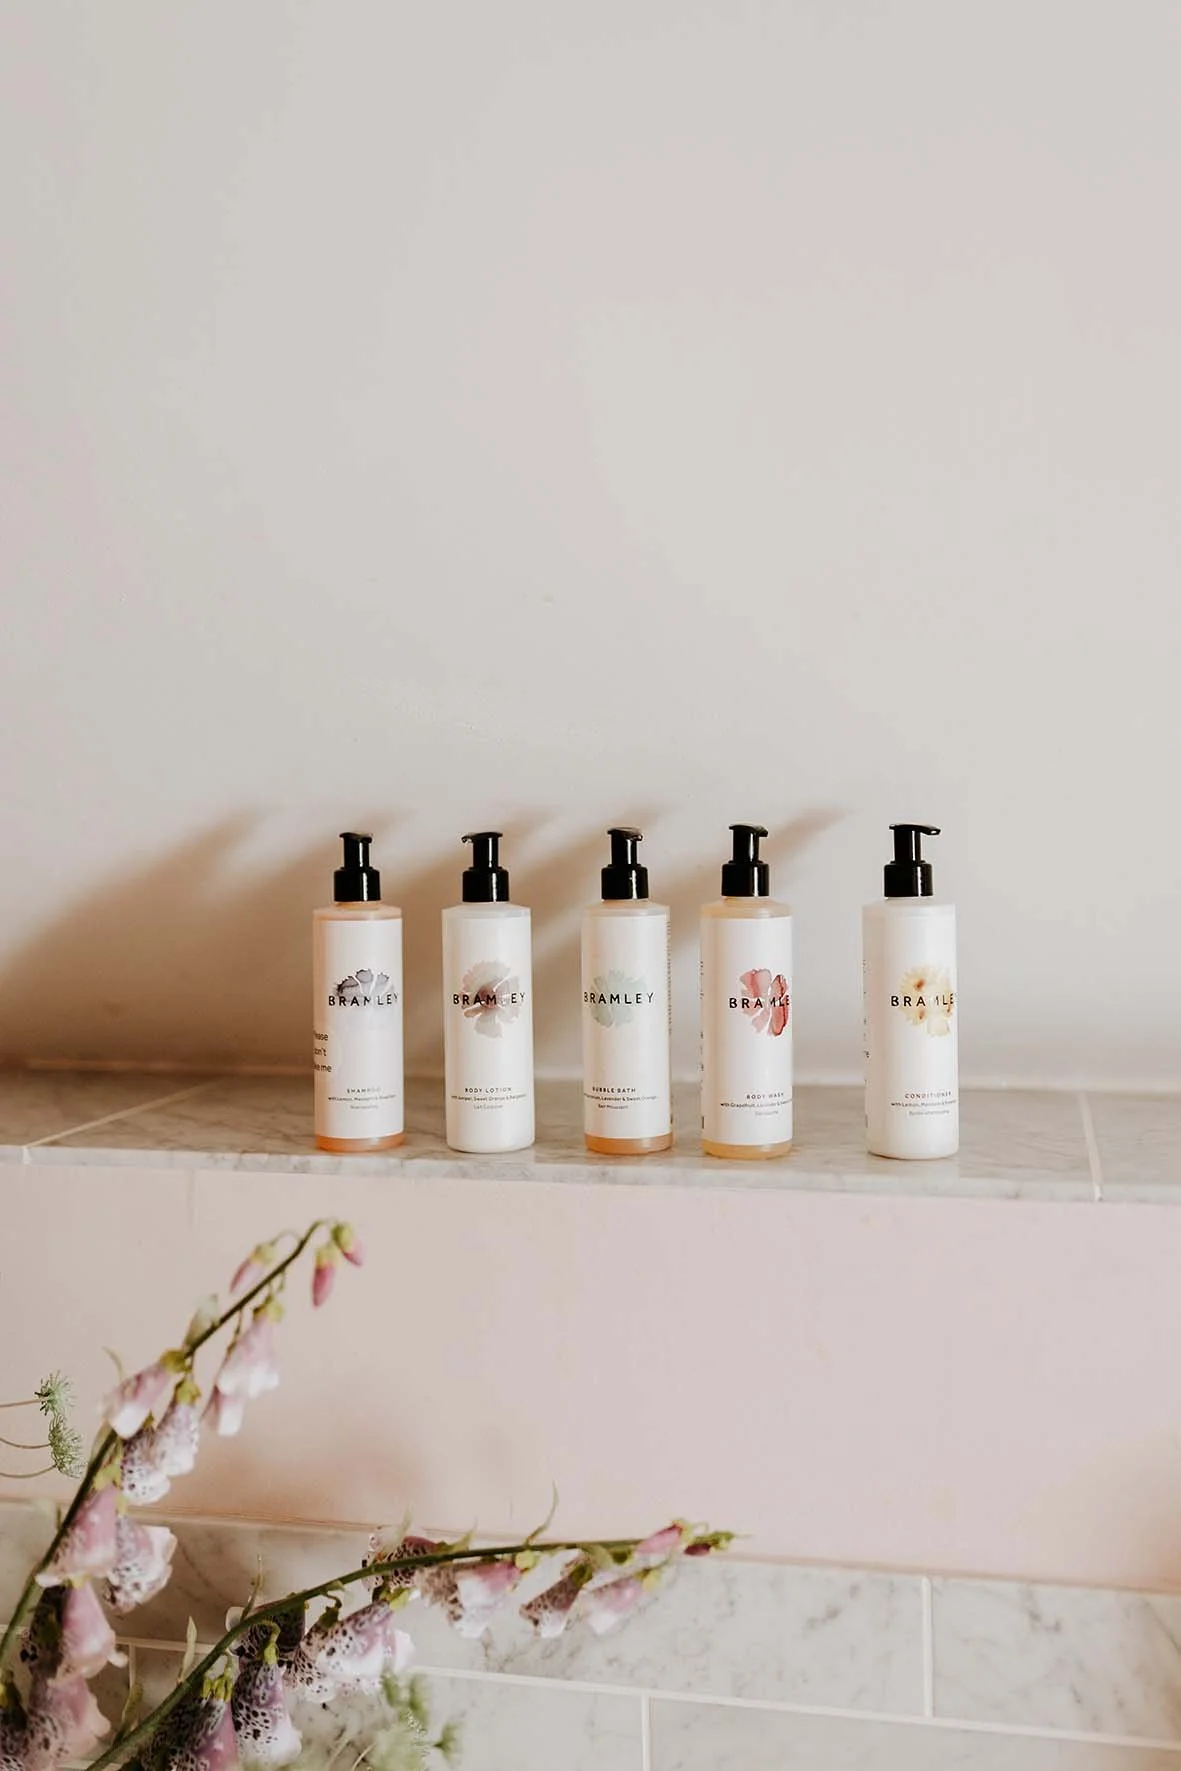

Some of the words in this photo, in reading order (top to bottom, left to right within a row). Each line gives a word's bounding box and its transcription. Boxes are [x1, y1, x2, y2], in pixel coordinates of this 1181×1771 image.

[453, 993, 526, 1006] BRAMEY
[583, 991, 654, 1005] BRAMLEY
[728, 994, 790, 1009] BRAMLE
[890, 993, 954, 1007] BRALE
